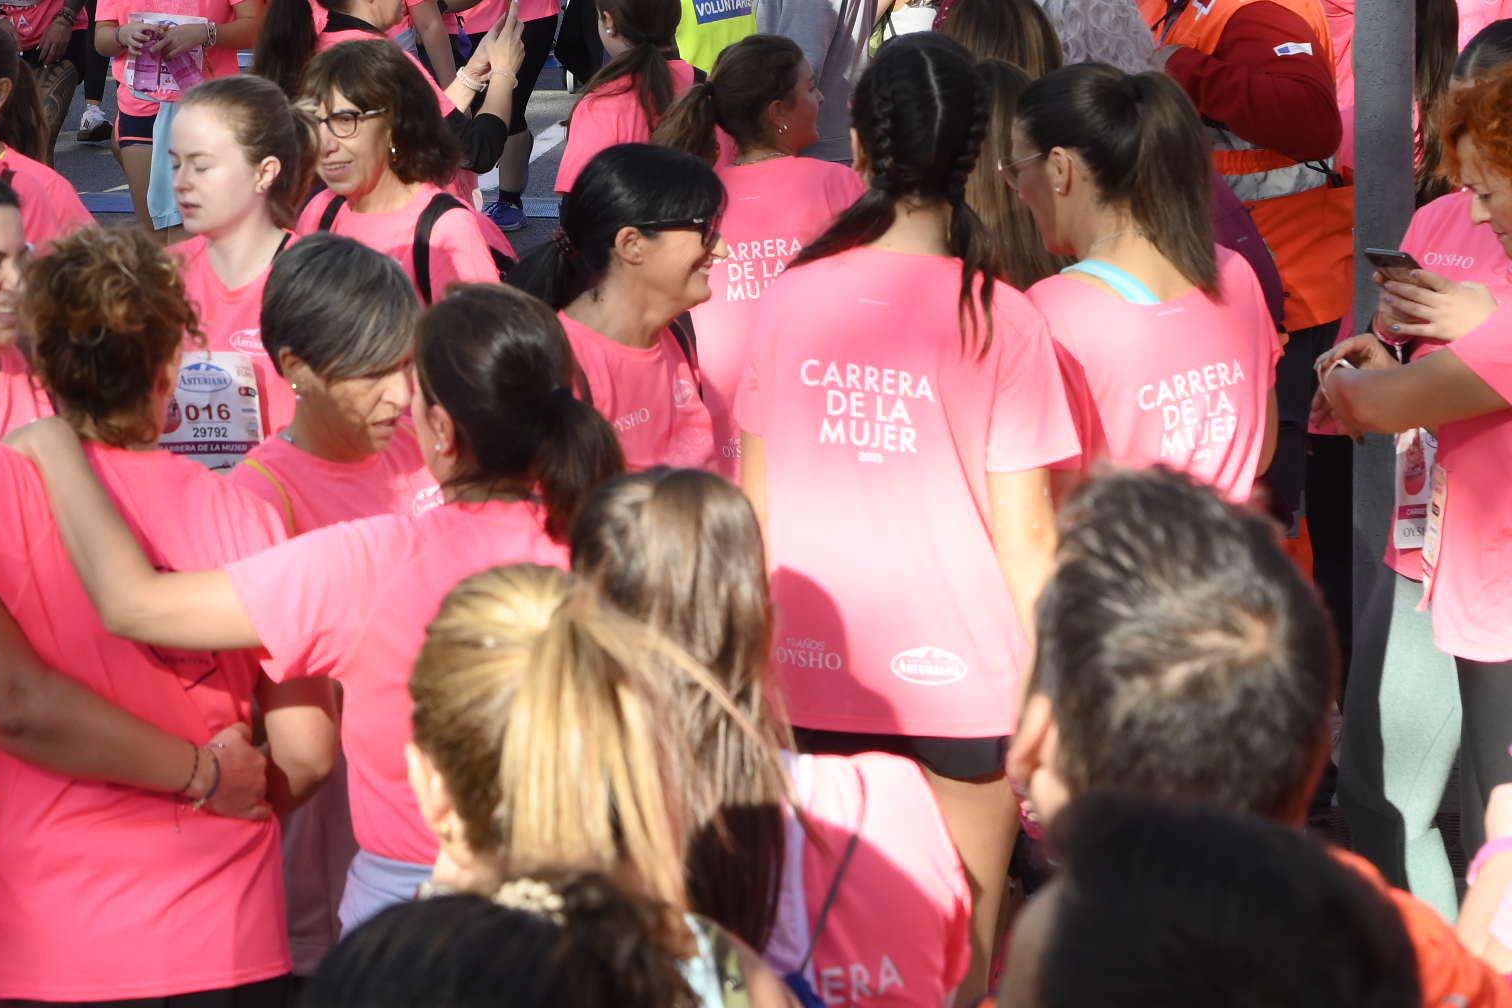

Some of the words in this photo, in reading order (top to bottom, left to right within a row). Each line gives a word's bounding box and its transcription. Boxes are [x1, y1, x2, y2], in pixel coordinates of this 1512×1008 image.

[713, 237, 803, 264] ARRERA
[1424, 252, 1474, 270] OYSHO
[728, 262, 755, 281] DE
[763, 259, 786, 278] LA
[180, 375, 228, 386] ASTURIANA
[800, 359, 936, 403] CARRERA
[1138, 358, 1245, 411] CARRERA
[185, 403, 231, 421] 016
[826, 390, 864, 420] DE
[875, 397, 912, 425] LA
[1163, 399, 1198, 431] DE
[193, 426, 228, 438] 29792
[819, 420, 918, 454] MUJER
[1403, 528, 1425, 538] OYS
[775, 646, 842, 671] OYSHO
